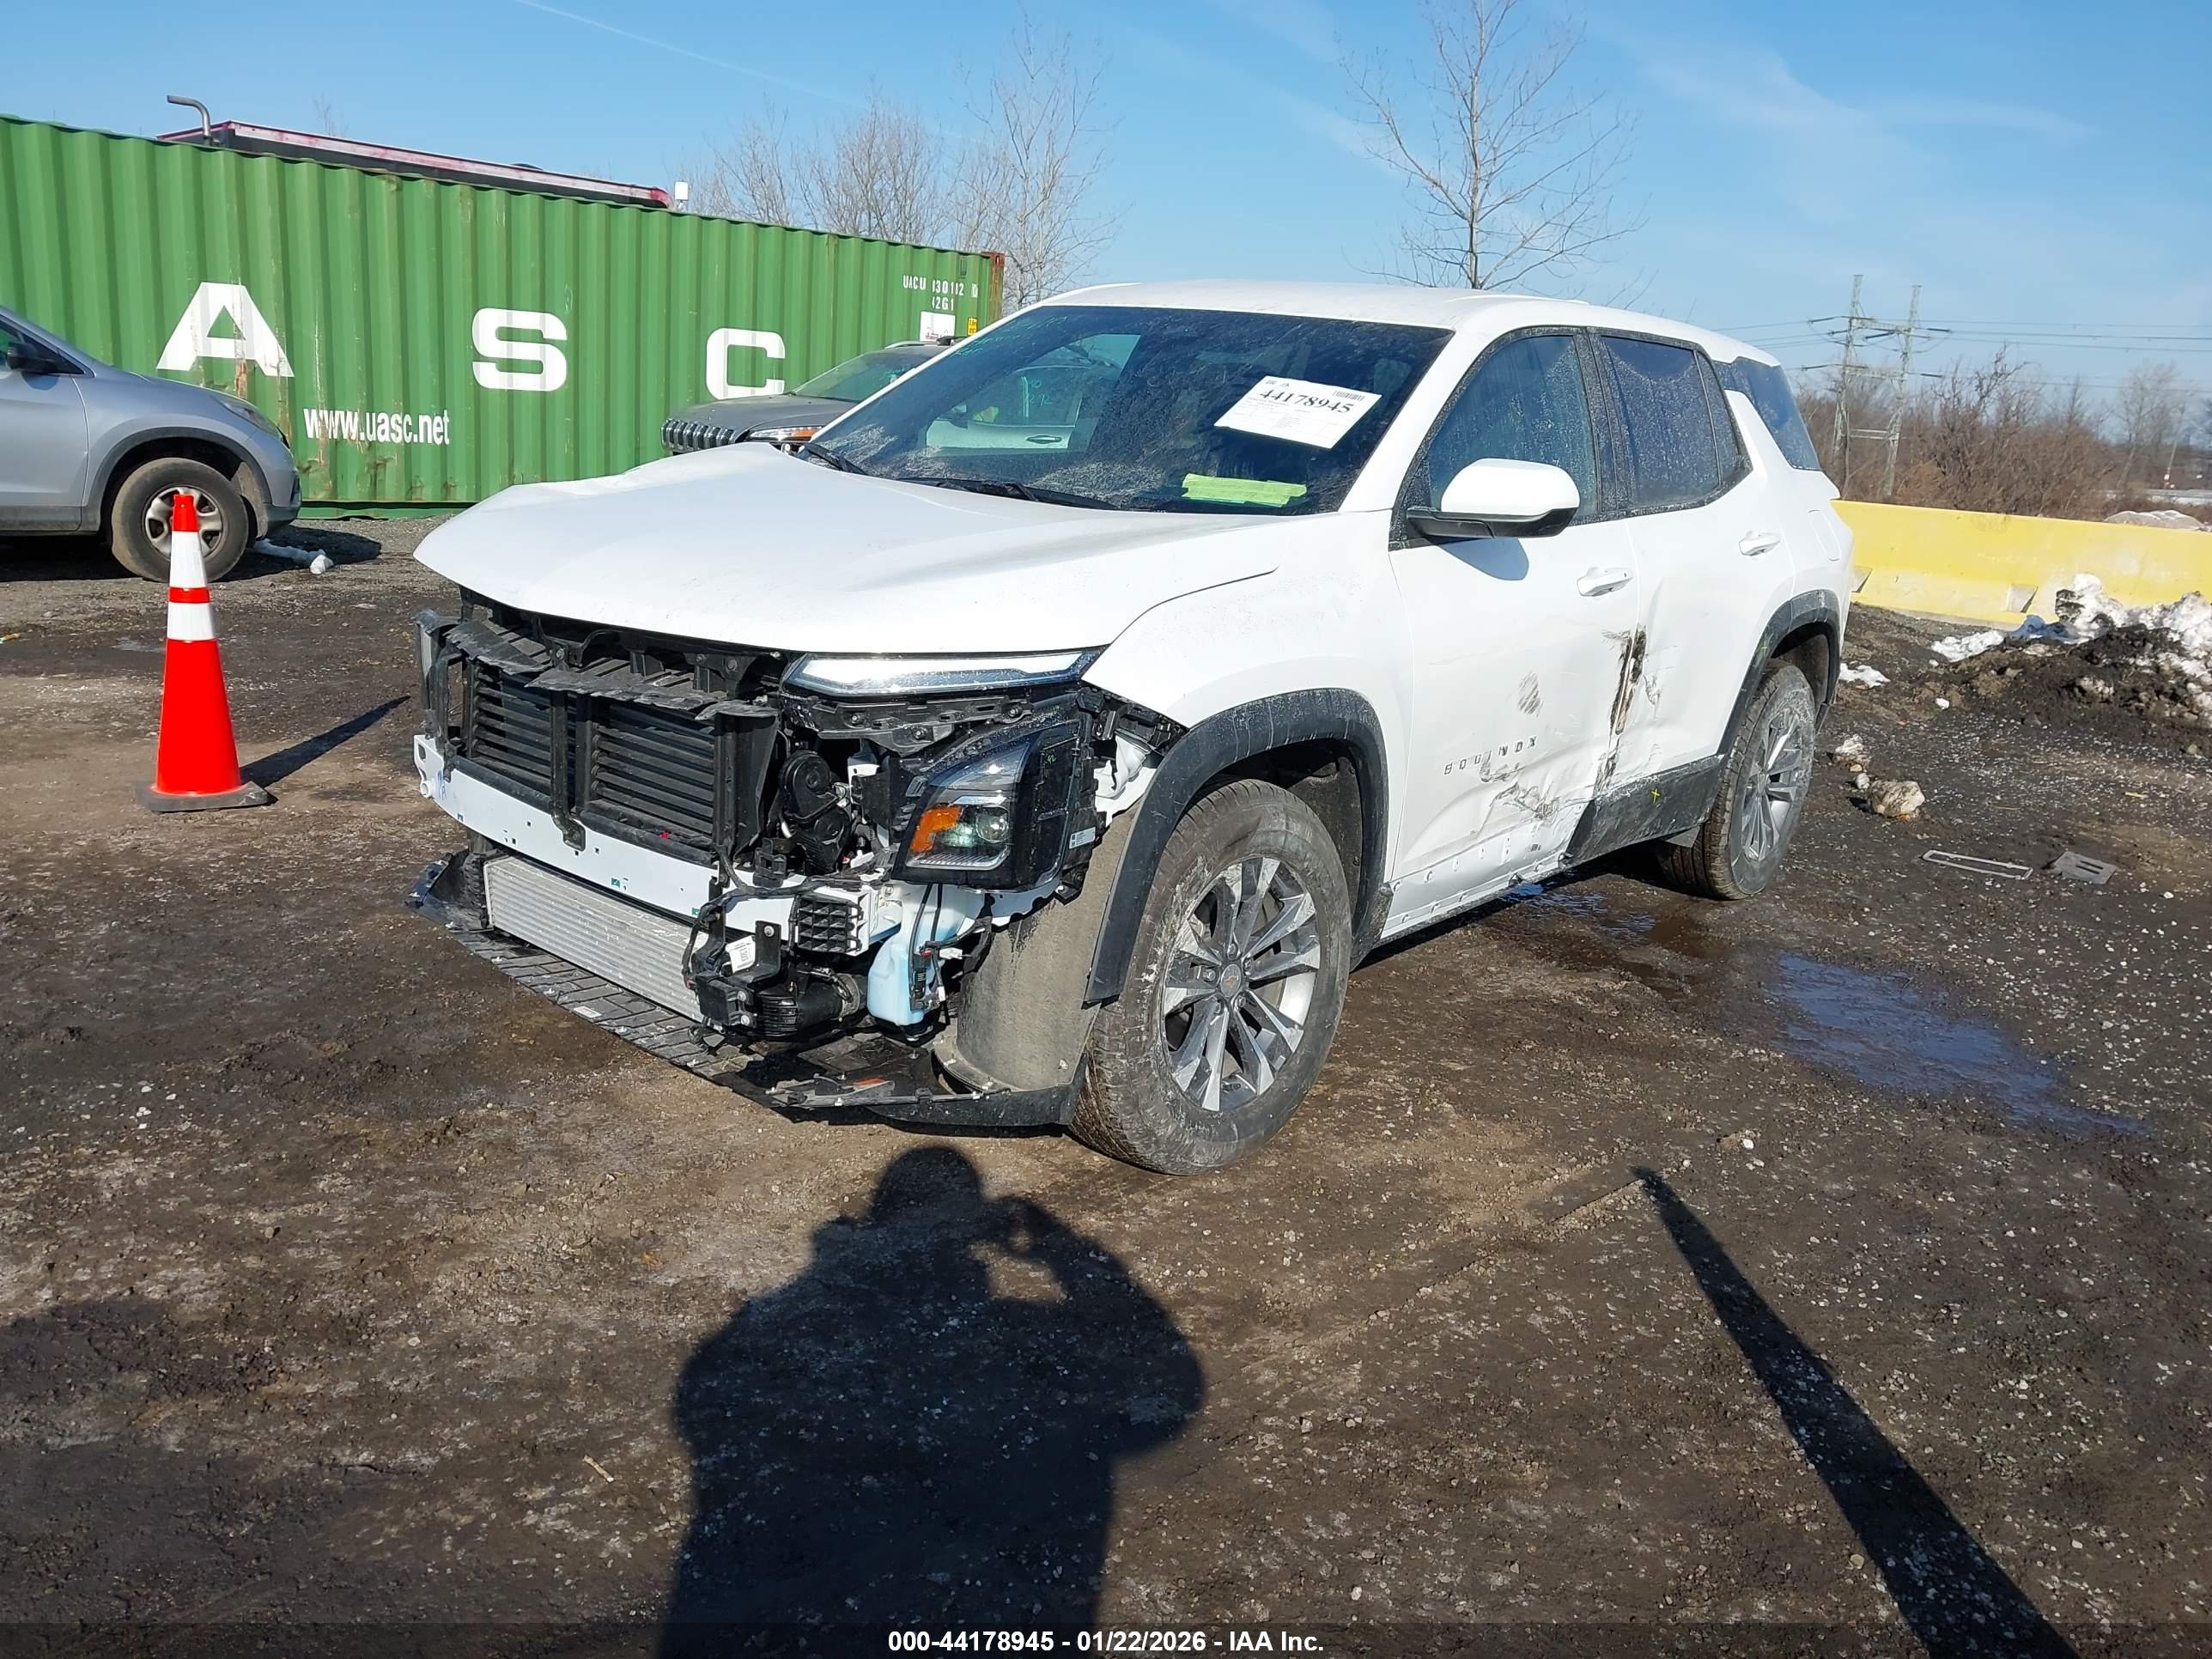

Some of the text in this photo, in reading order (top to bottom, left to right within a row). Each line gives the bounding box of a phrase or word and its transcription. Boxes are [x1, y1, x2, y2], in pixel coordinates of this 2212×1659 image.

[902, 275, 927, 290] UACU
[156, 282, 786, 398] A S C
[1259, 389, 1354, 414] 44178945
[303, 408, 450, 446] www.uasc.net
